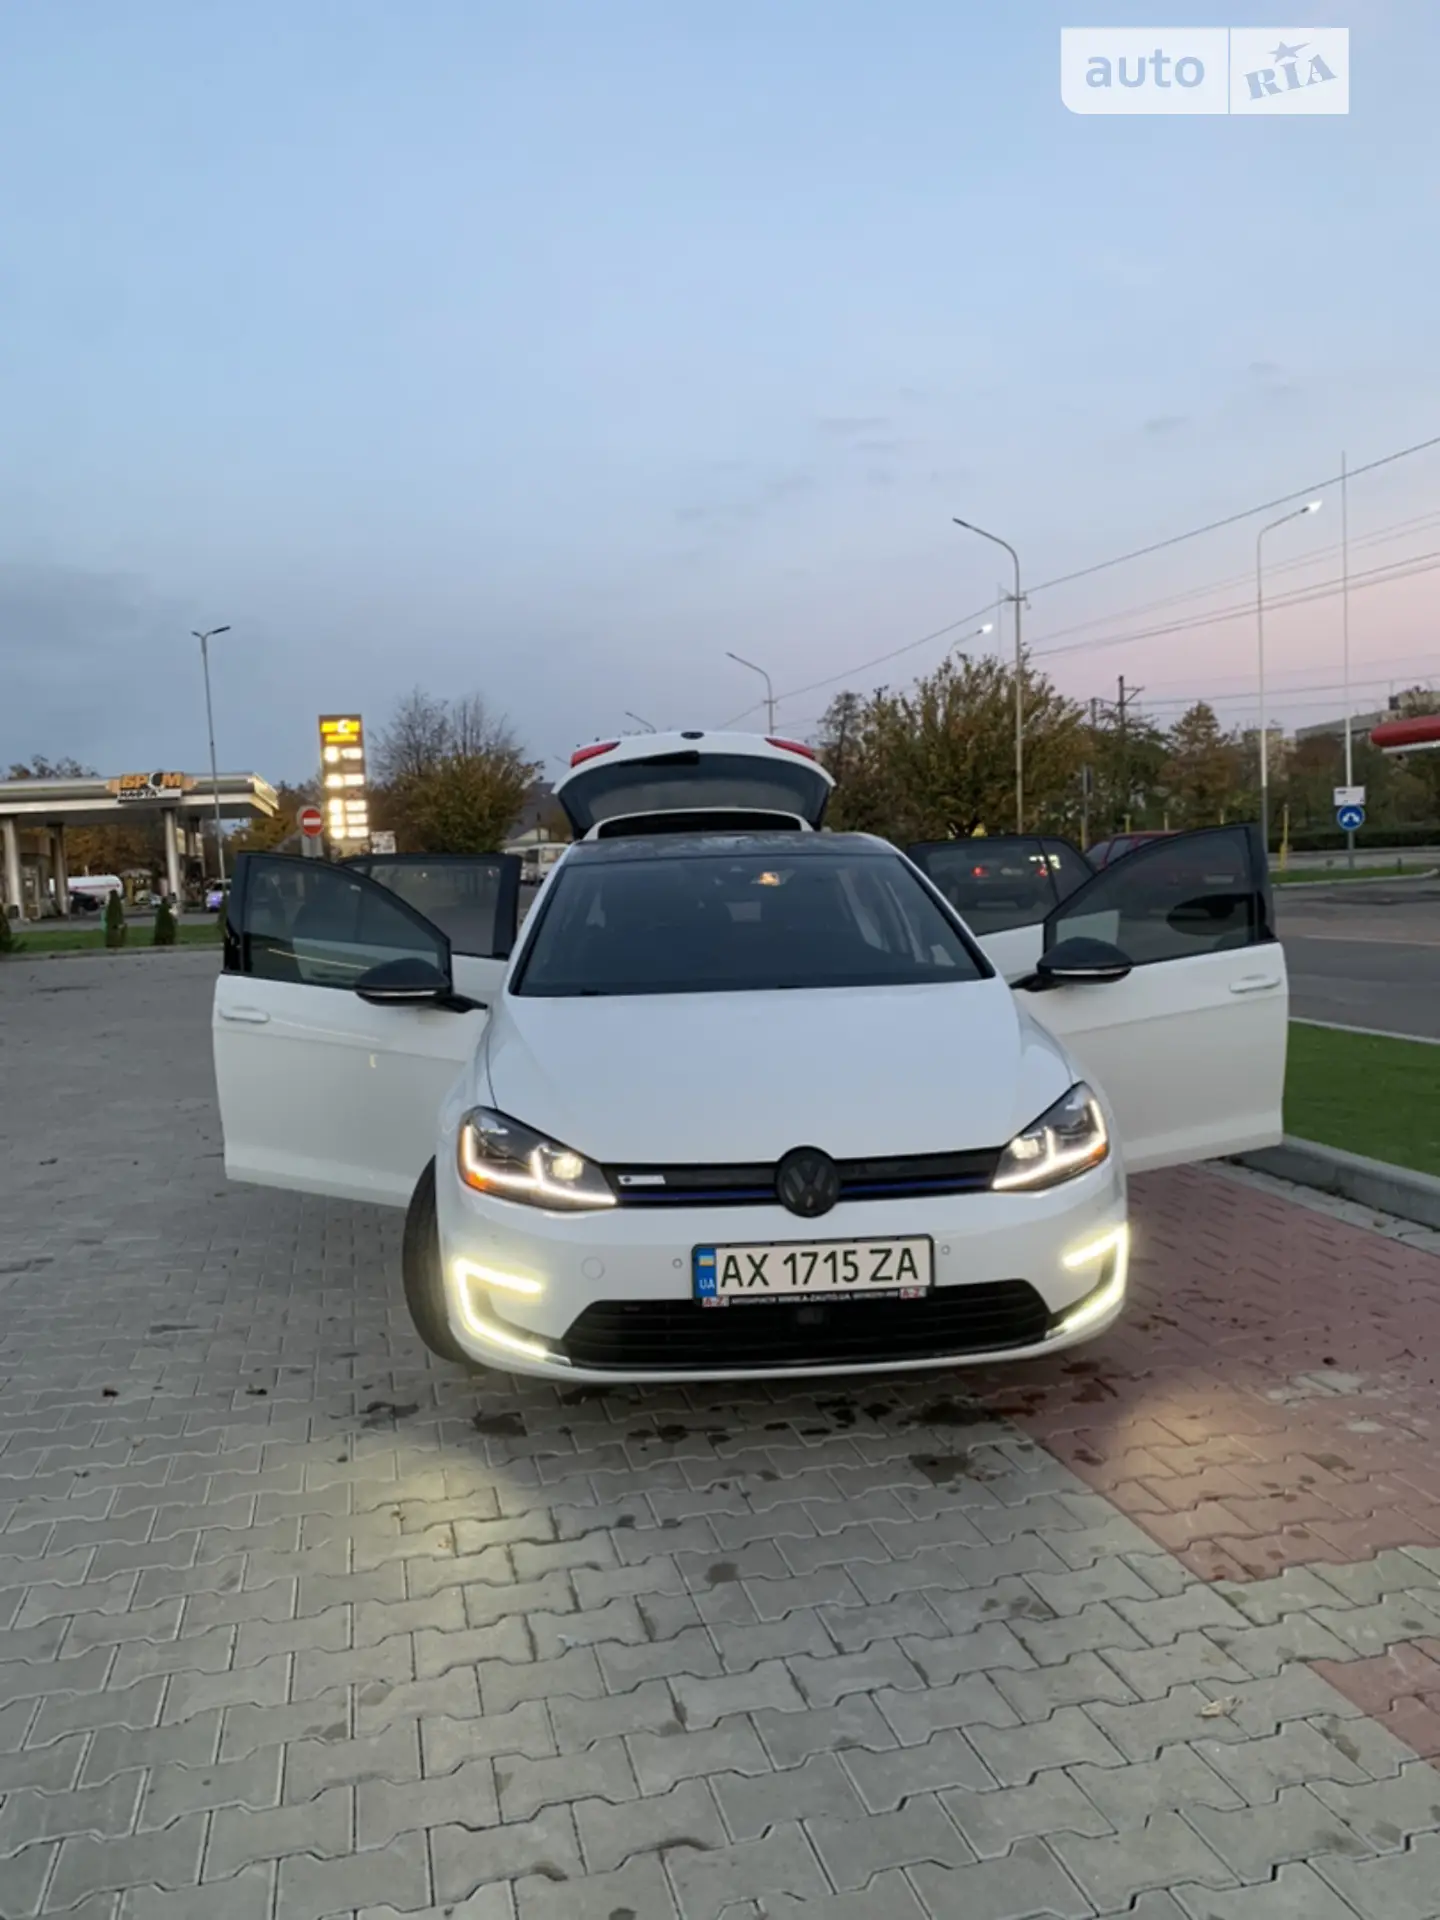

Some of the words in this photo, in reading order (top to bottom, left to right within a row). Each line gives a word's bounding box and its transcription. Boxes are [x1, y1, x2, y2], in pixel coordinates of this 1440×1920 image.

[720, 1253, 770, 1288] AX
[782, 1250, 859, 1286] 1715
[869, 1247, 919, 1282] ZA
[699, 1279, 716, 1290] UA
